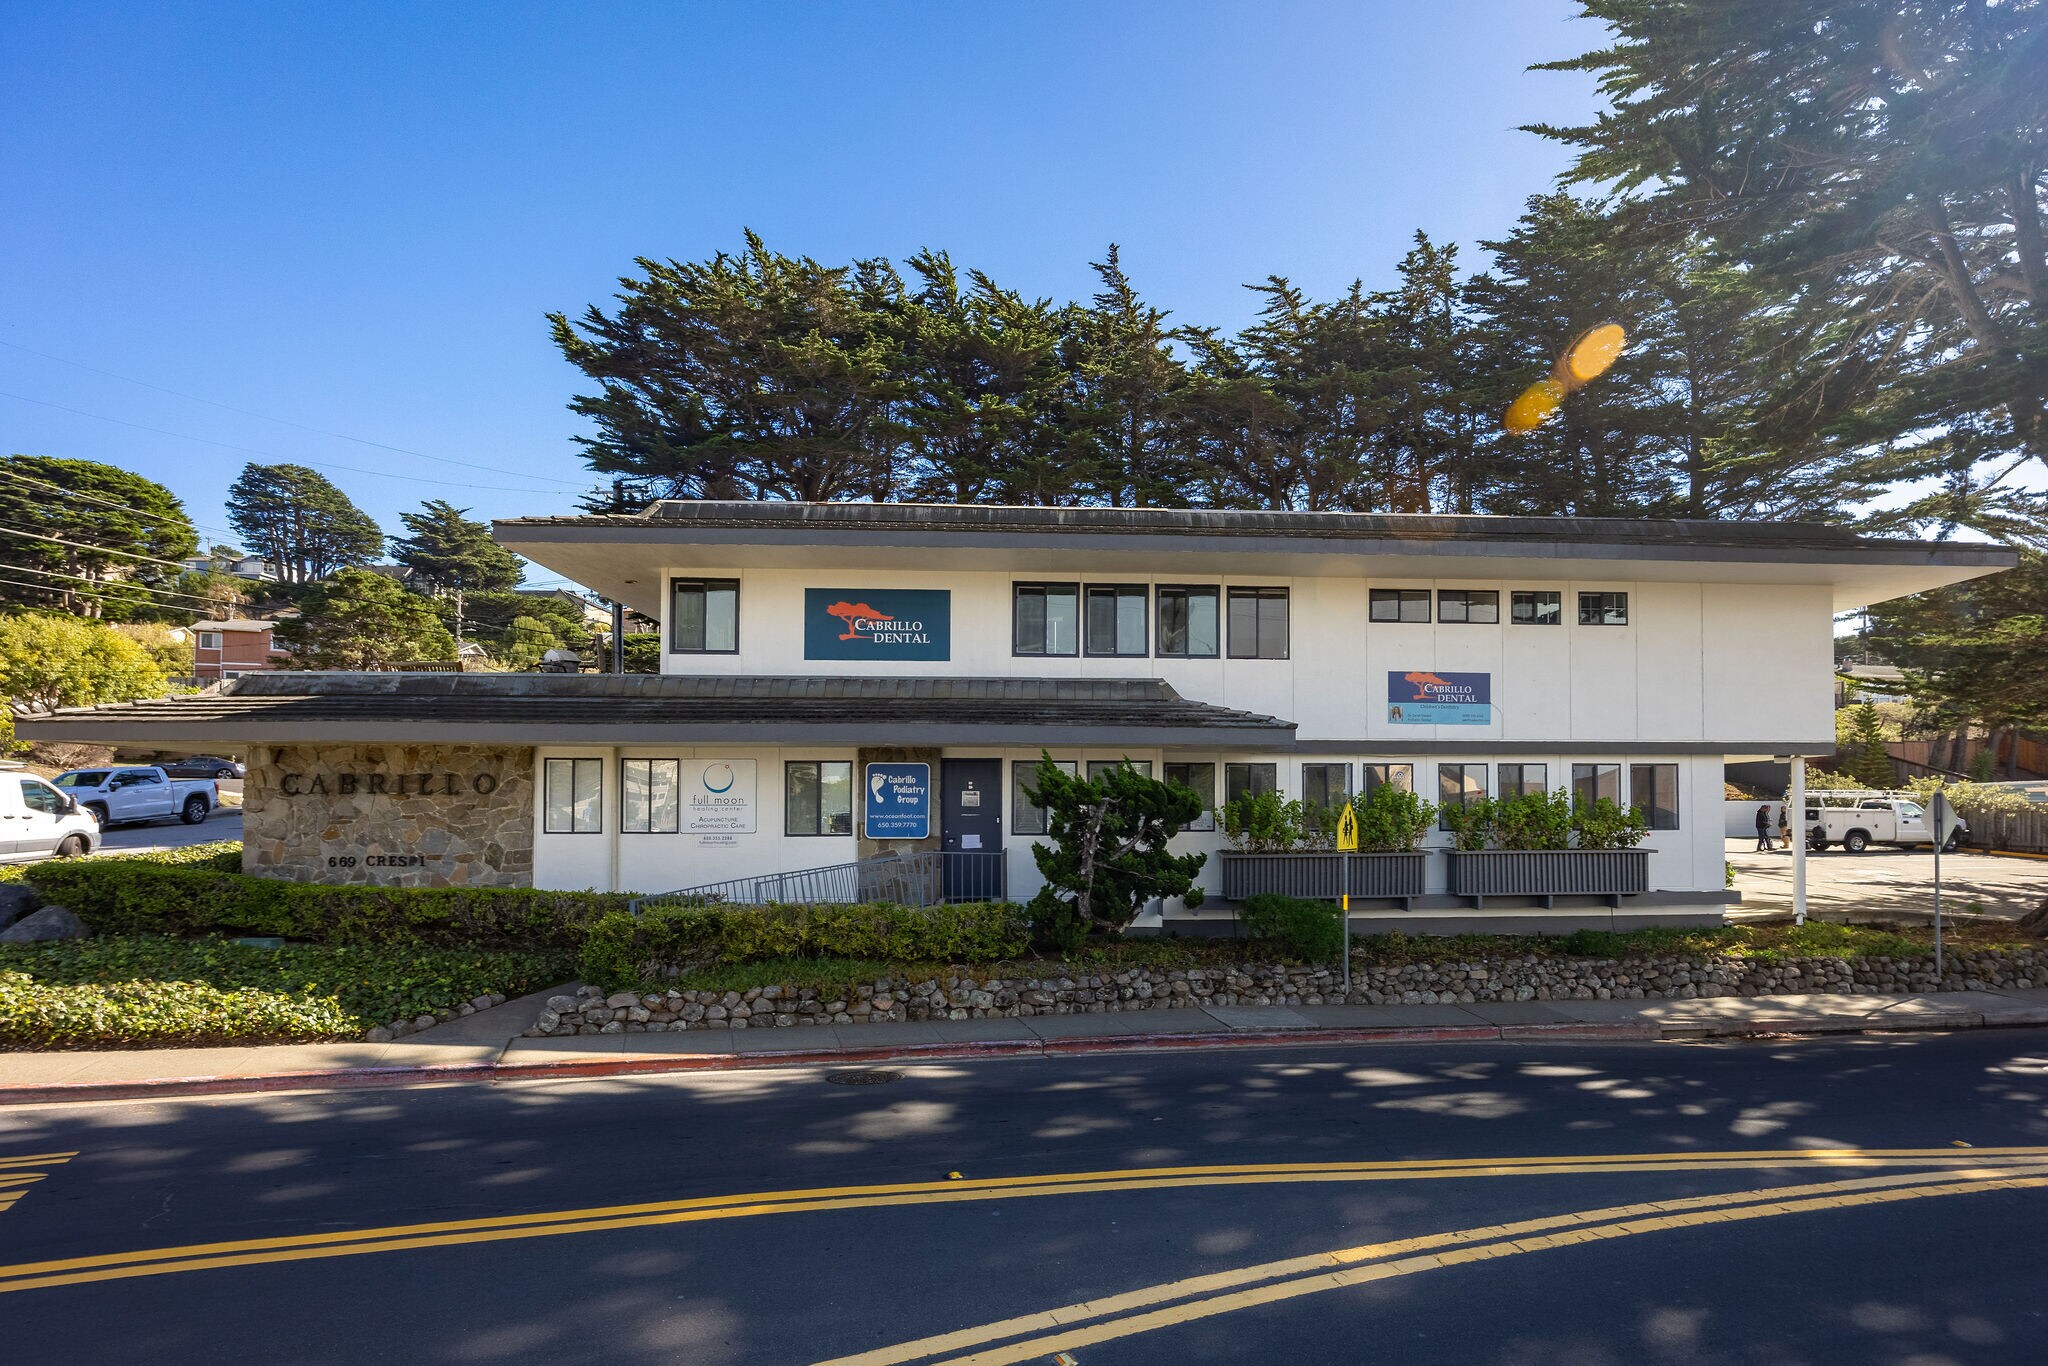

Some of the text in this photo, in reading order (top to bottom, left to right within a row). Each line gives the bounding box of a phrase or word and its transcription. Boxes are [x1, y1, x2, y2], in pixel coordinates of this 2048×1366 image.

[854, 618, 923, 631] CABRILLO
[873, 632, 931, 644] DENTAL
[1424, 683, 1472, 694] CABRILLO
[1437, 694, 1477, 703] DENTAL
[280, 773, 497, 796] CABRILLO
[888, 775, 917, 784] Cabrillo
[893, 785, 926, 795] Podiatry
[693, 794, 709, 804] full
[897, 795, 919, 805] Group
[328, 856, 357, 867] 669
